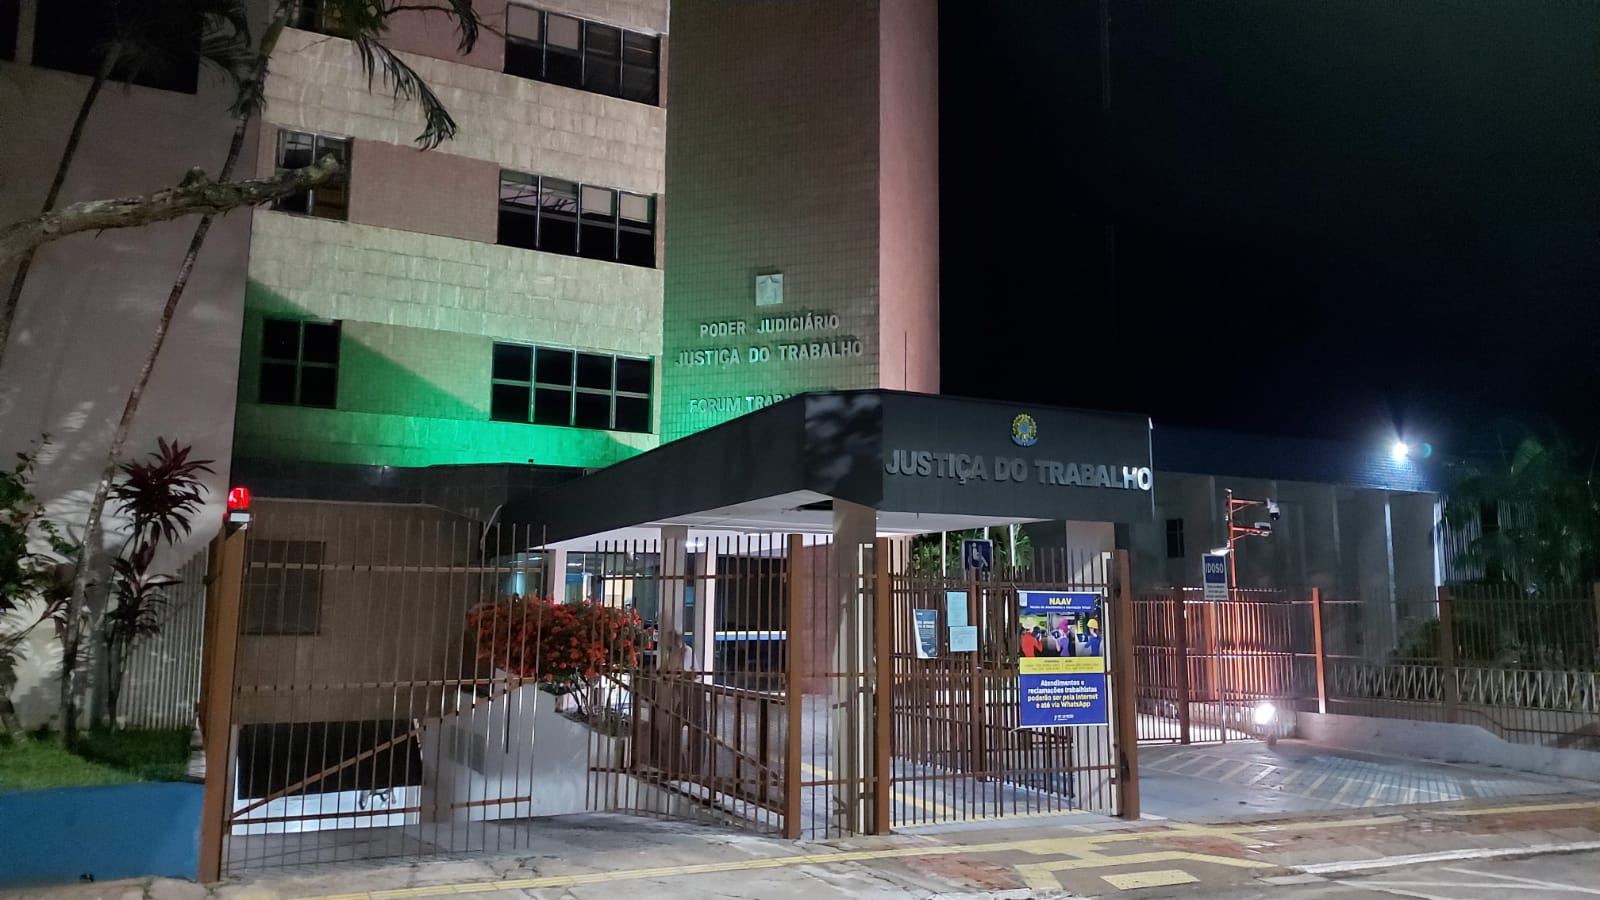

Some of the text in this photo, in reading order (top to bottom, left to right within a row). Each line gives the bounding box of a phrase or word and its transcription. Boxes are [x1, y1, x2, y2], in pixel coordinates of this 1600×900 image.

[700, 313, 839, 338] PODER JUDICIÁRIO
[749, 347, 770, 363] DO
[778, 341, 863, 362] TRABALHO
[885, 450, 1152, 490] JUSTIÇA DO TRABALHO
[1205, 563, 1224, 574] IDOSO
